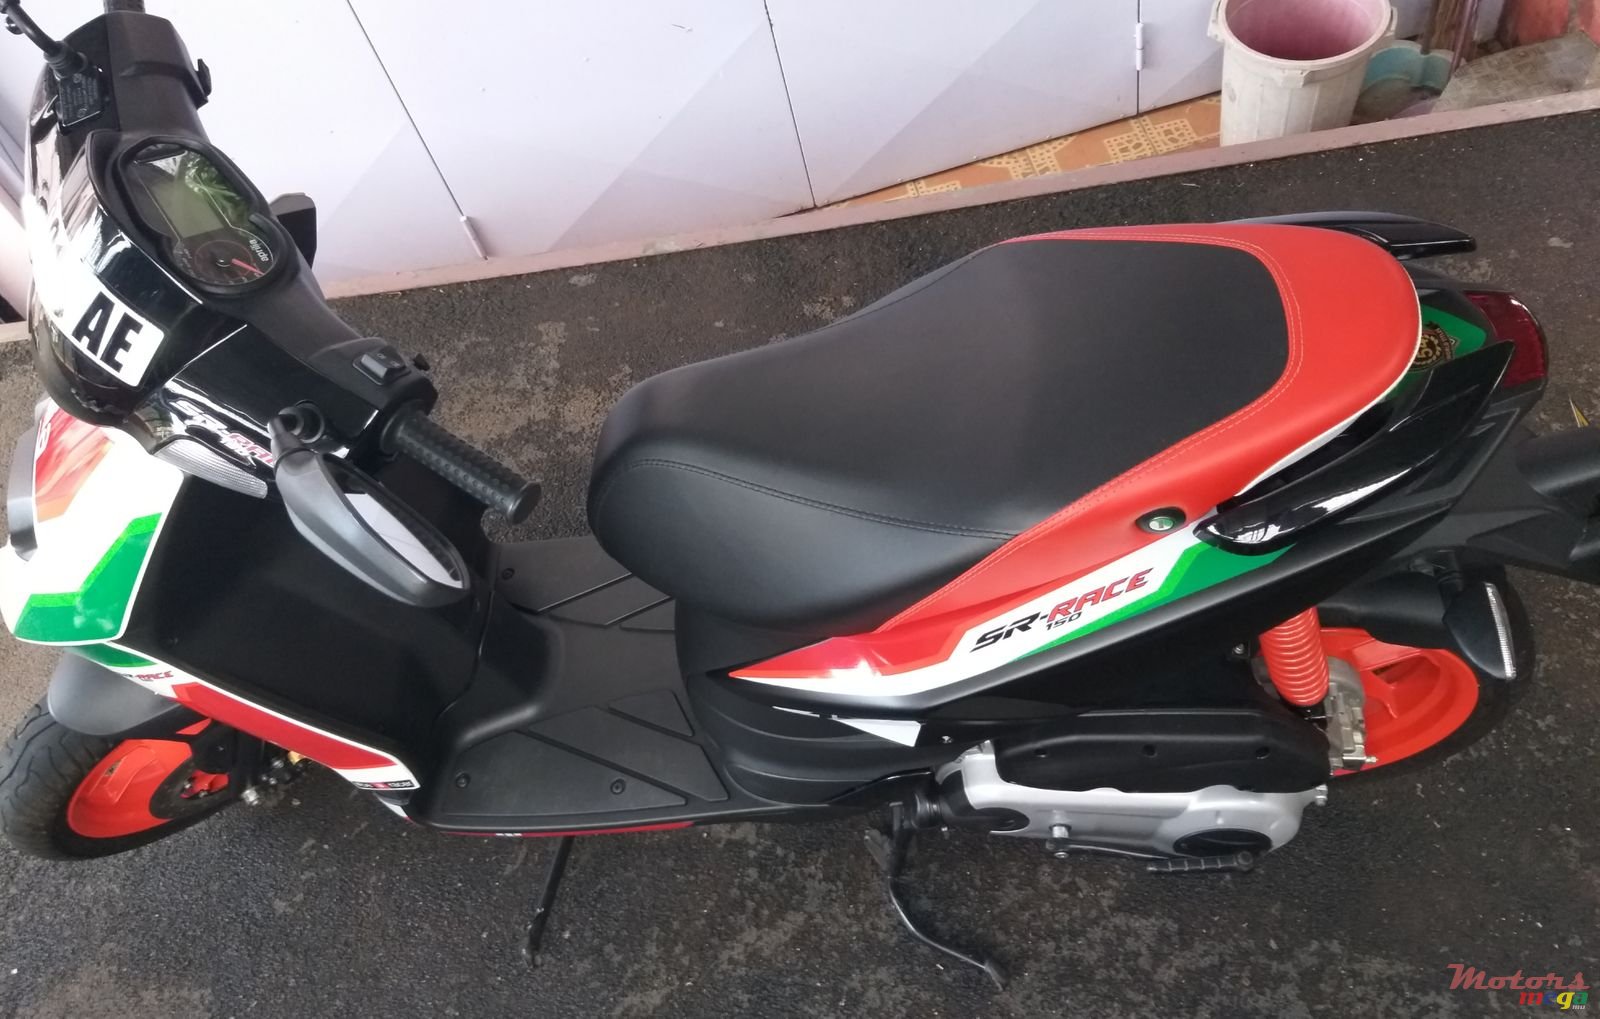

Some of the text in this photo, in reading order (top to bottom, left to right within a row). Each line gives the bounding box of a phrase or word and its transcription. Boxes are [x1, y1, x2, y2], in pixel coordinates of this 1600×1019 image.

[249, 239, 269, 262] aprilia
[72, 291, 143, 373] AE
[969, 567, 1154, 653] SR-RACE
[1046, 611, 1082, 631] 150
